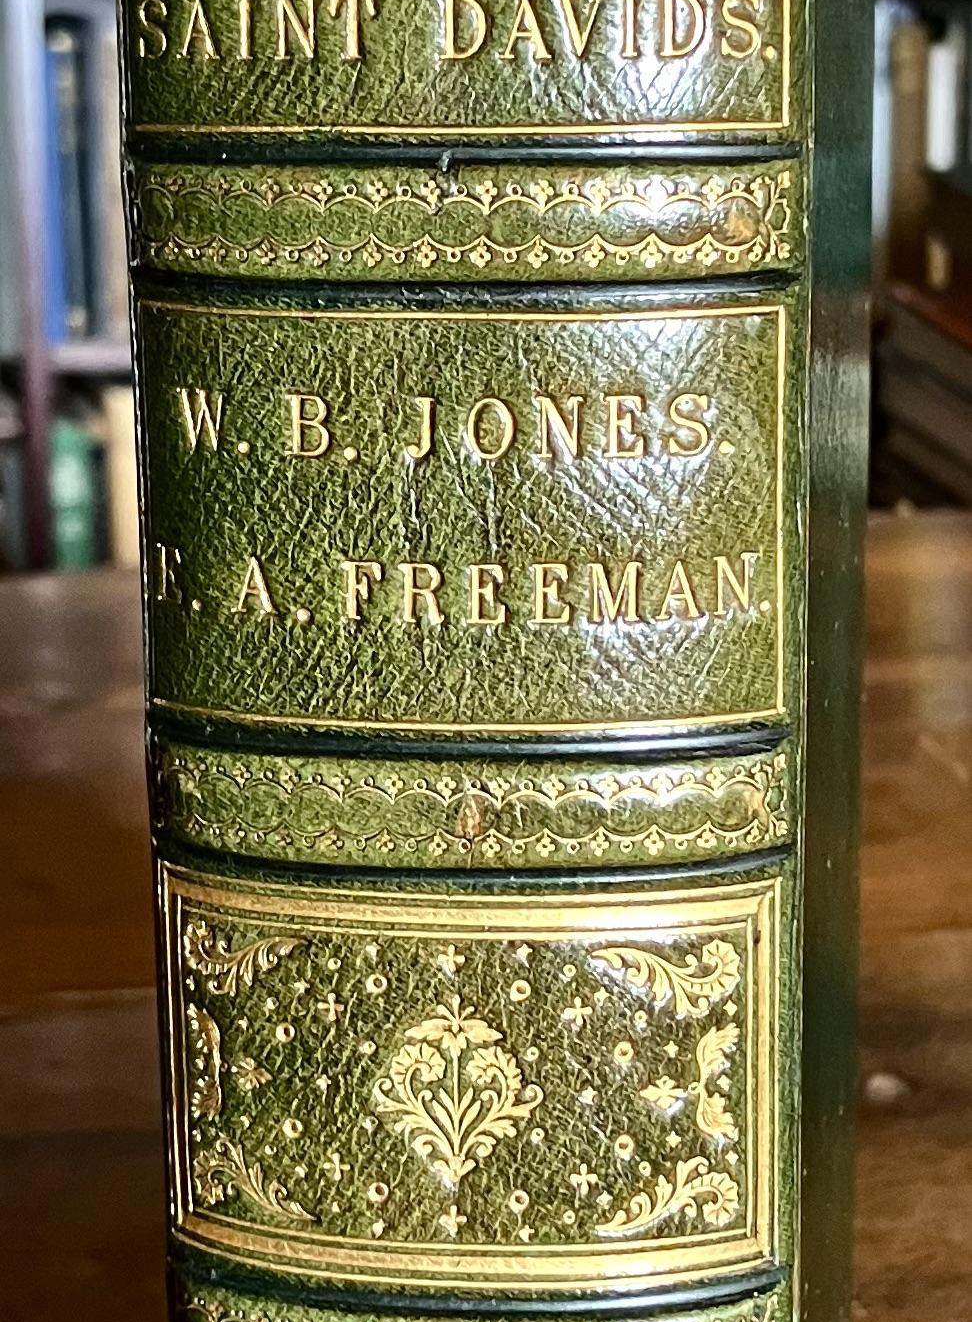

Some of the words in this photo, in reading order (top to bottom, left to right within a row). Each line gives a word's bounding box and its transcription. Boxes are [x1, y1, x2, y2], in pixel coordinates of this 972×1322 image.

[176, 387, 250, 455] W.
[284, 394, 358, 457] B.
[406, 393, 735, 460] JONES.
[231, 556, 311, 622] A.
[339, 551, 771, 625] FREEMAN.
